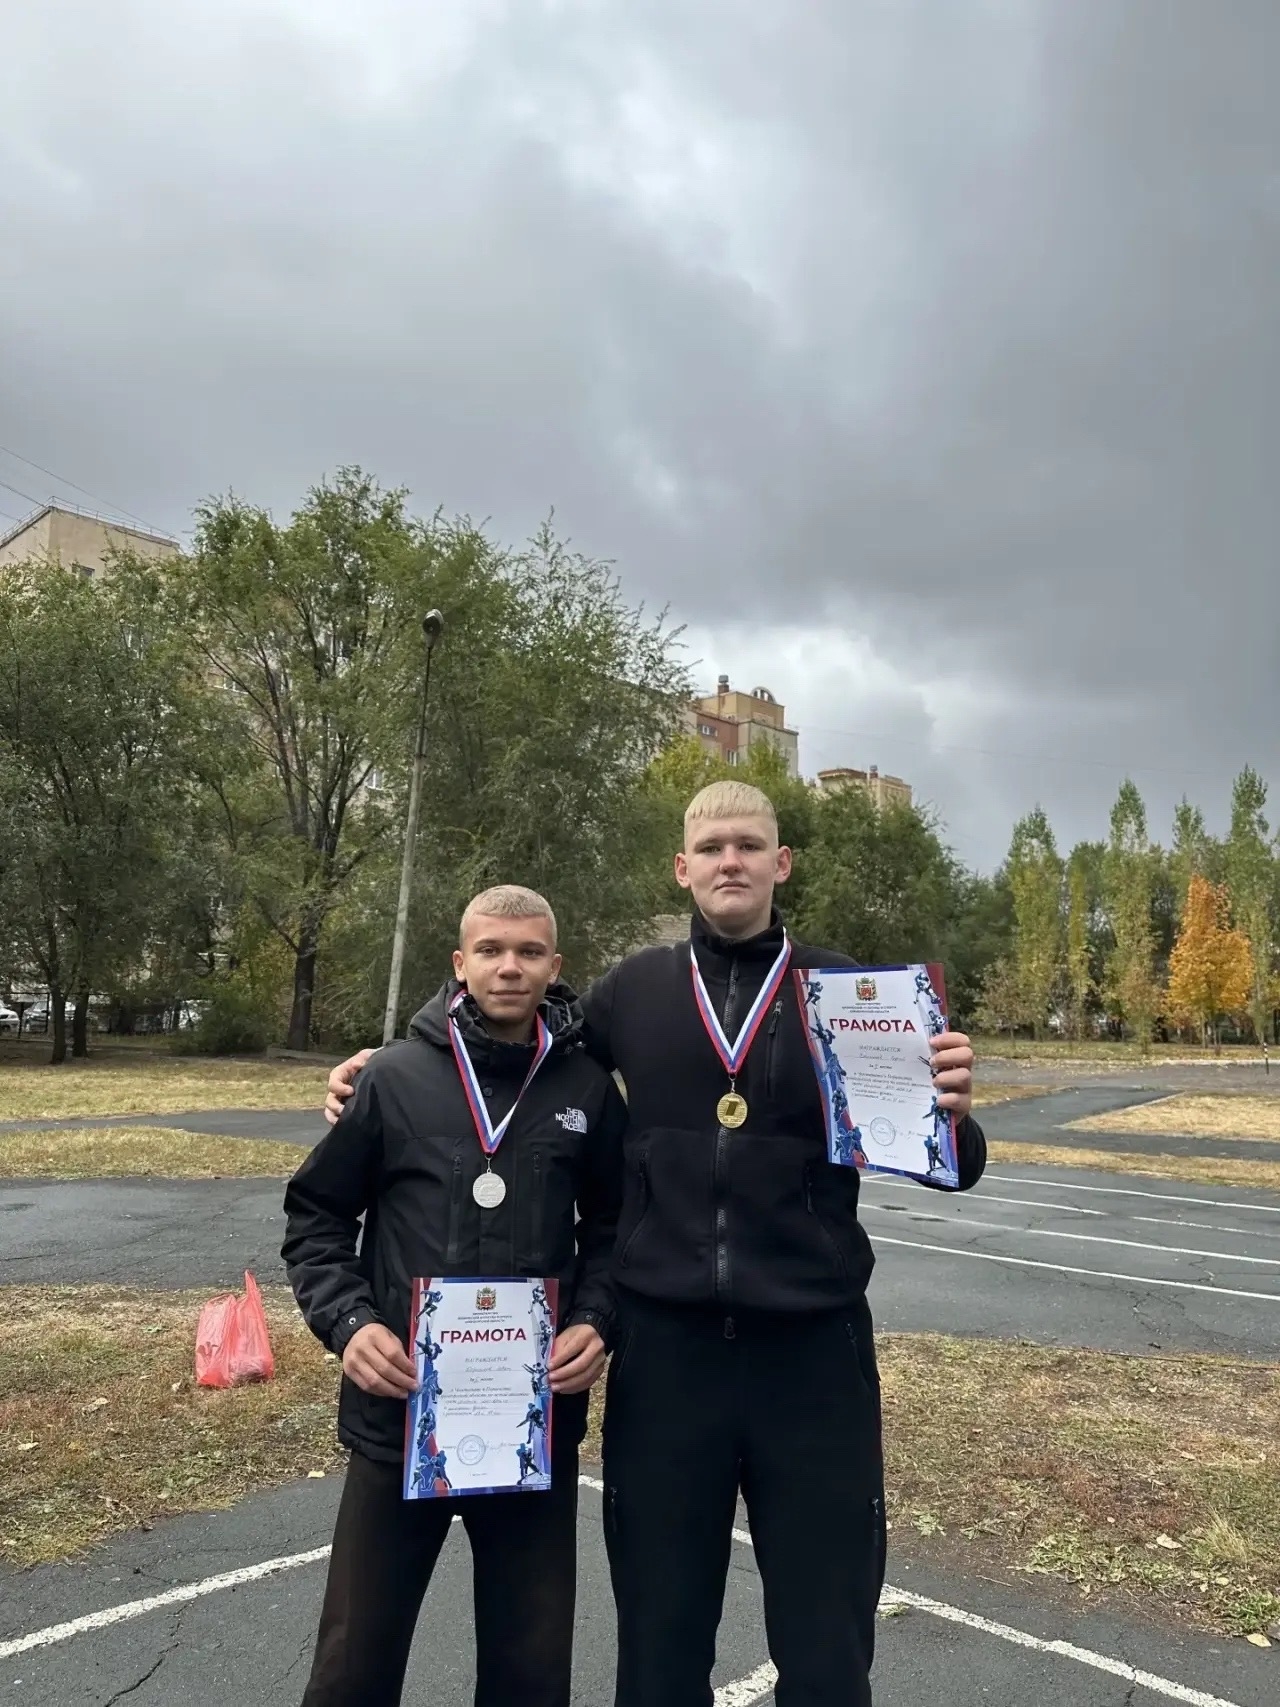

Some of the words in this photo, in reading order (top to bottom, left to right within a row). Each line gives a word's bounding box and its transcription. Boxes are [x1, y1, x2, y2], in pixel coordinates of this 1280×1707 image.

[828, 1018, 916, 1033] ГРАМОТА
[555, 1112, 578, 1125] NORTH
[565, 1107, 578, 1117] THE
[562, 1121, 578, 1132] FACE
[440, 1328, 527, 1343] ГРАМОТА
